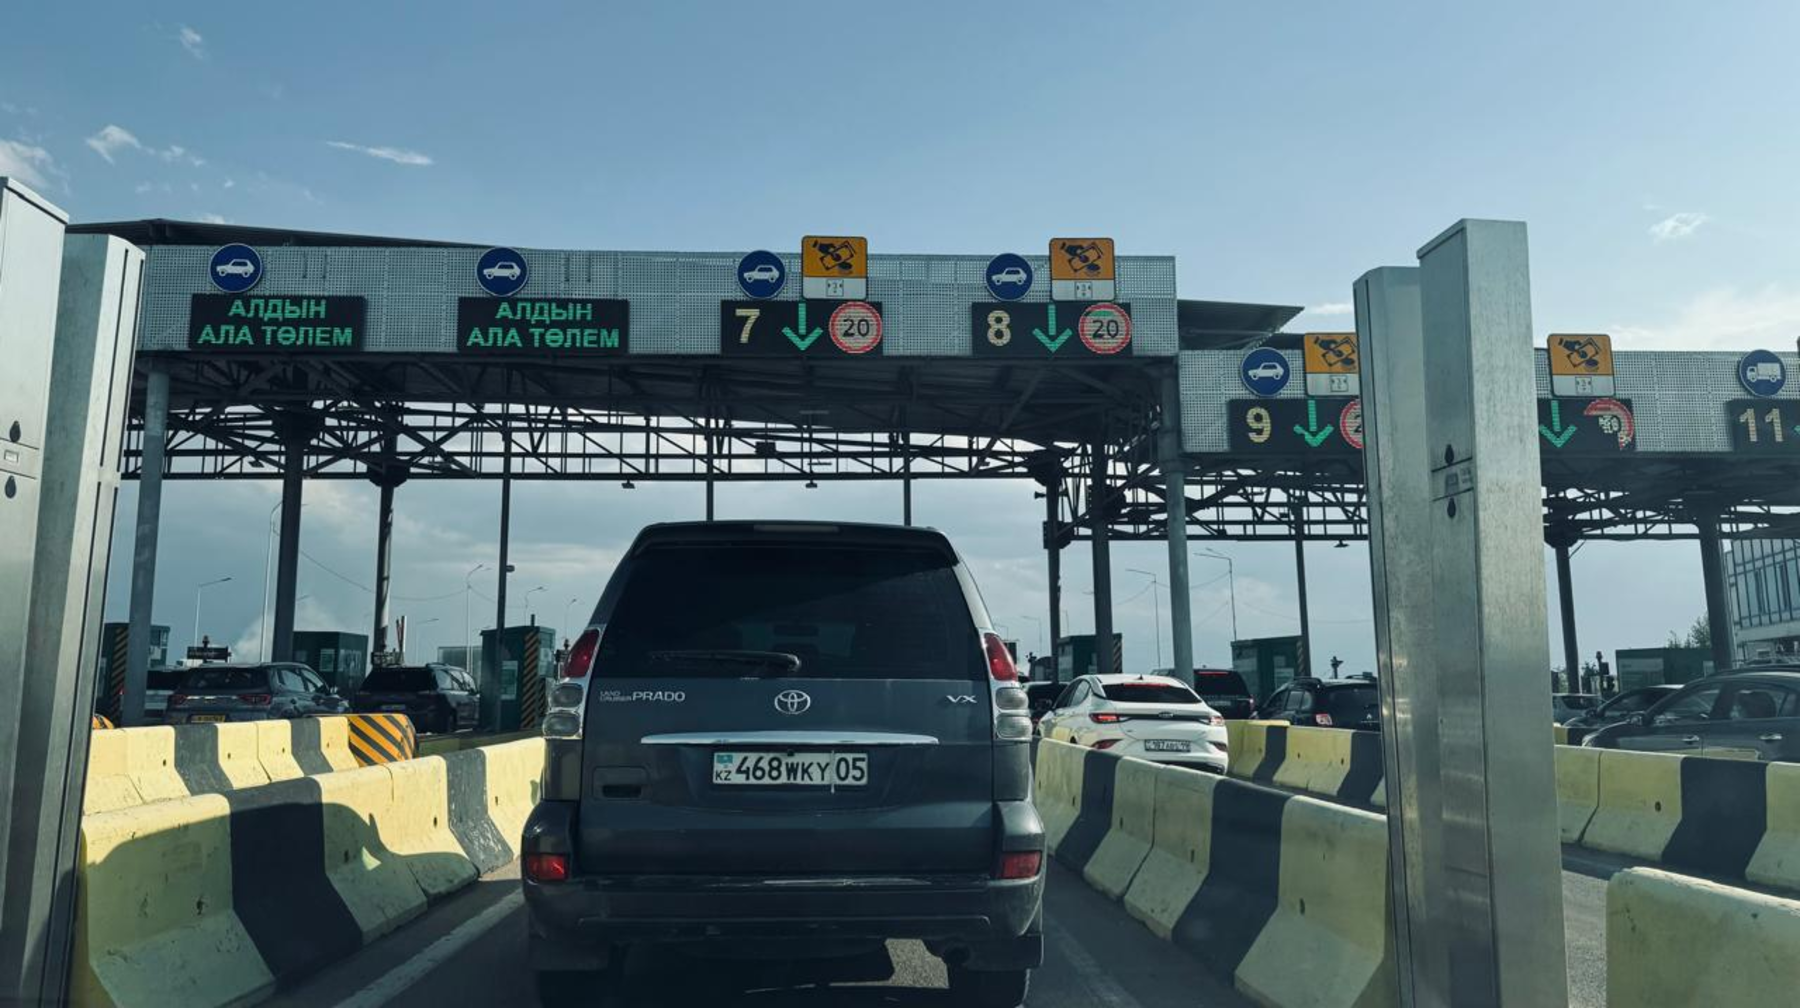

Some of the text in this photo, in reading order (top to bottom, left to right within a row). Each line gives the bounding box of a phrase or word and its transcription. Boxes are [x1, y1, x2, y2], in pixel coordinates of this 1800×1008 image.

[228, 299, 327, 322] АЛДЫН
[495, 302, 593, 324] АЛДЫН
[197, 325, 353, 346] АЛА ТӨЛЕМ
[735, 308, 761, 344] 7
[842, 318, 870, 338] 20
[987, 310, 1012, 346] 8
[1091, 319, 1120, 339] 20
[466, 327, 620, 348] АЛА ТӨЛЕМ
[1246, 407, 1272, 443] 9
[1739, 408, 1784, 442] 11
[632, 691, 686, 702] PRADO
[946, 695, 978, 704] VX
[715, 770, 732, 781] KZ
